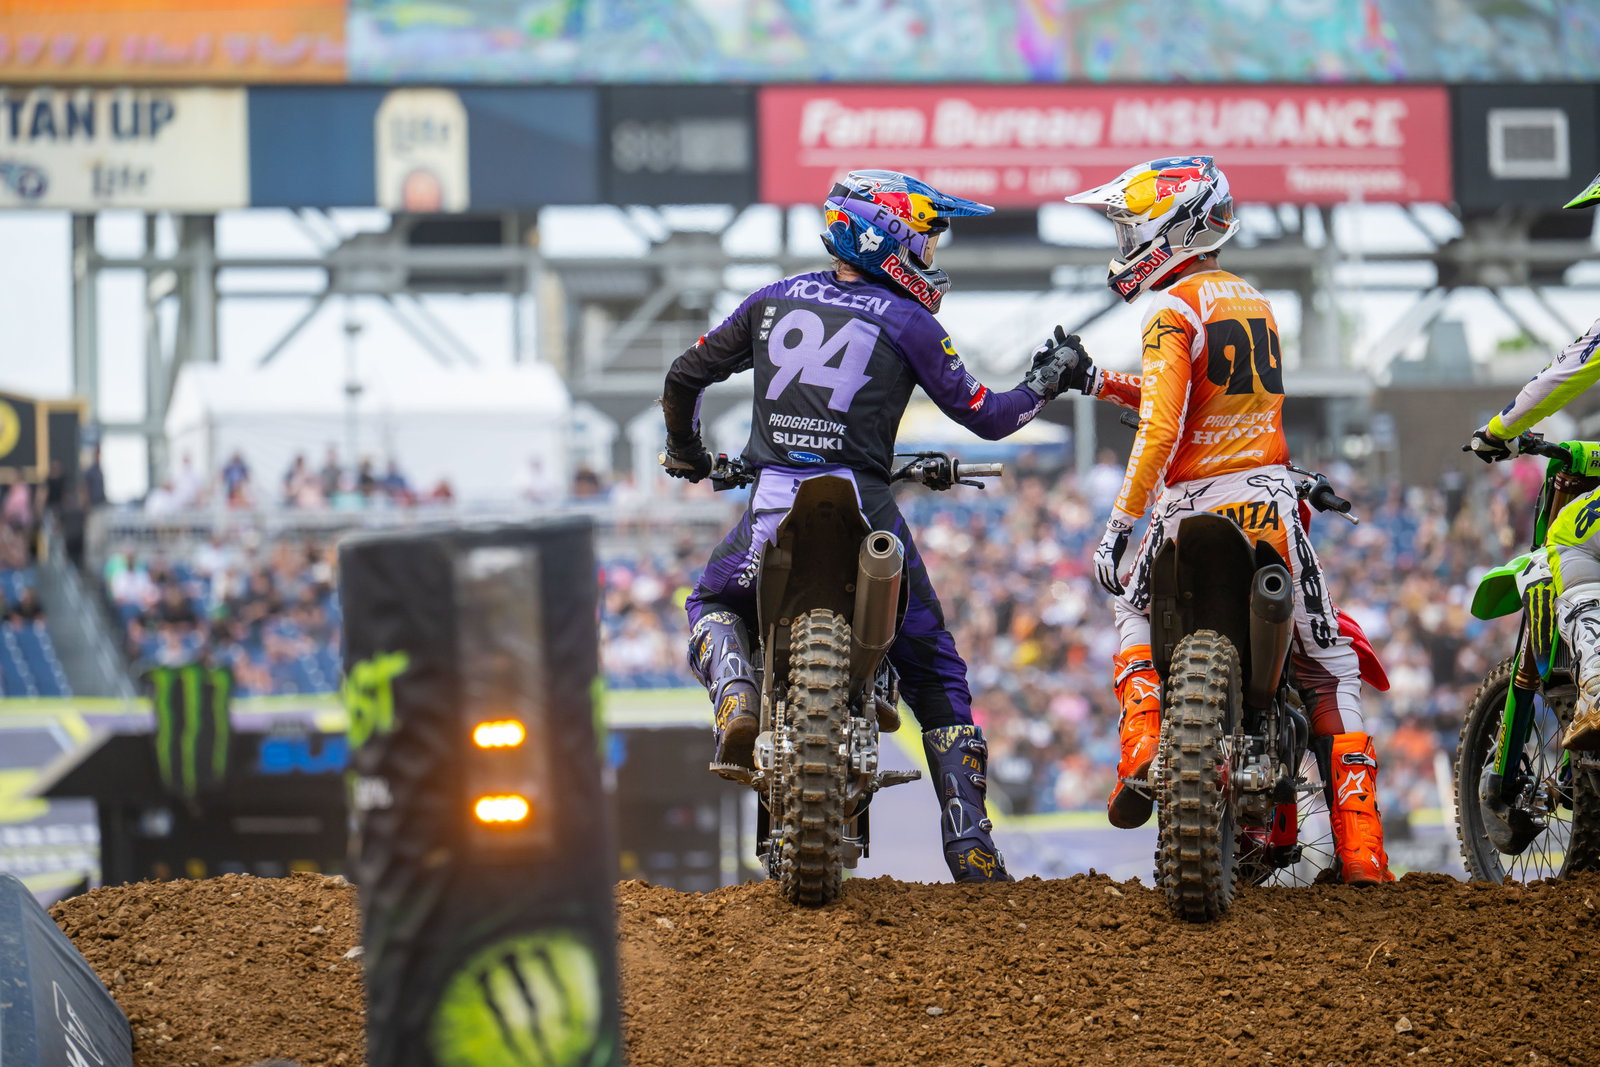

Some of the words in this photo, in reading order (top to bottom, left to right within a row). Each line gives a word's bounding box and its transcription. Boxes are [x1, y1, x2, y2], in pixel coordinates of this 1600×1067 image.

[801, 98, 926, 148] Farm
[934, 98, 1103, 148] Bureau
[1110, 98, 1406, 147] INSURANCE
[873, 209, 916, 247] FOX
[785, 280, 891, 316] ROCZEN
[765, 309, 882, 413] 94
[768, 413, 847, 436] PROGRESSIVE
[772, 431, 842, 450] SUZUKI
[961, 755, 981, 773] FOX
